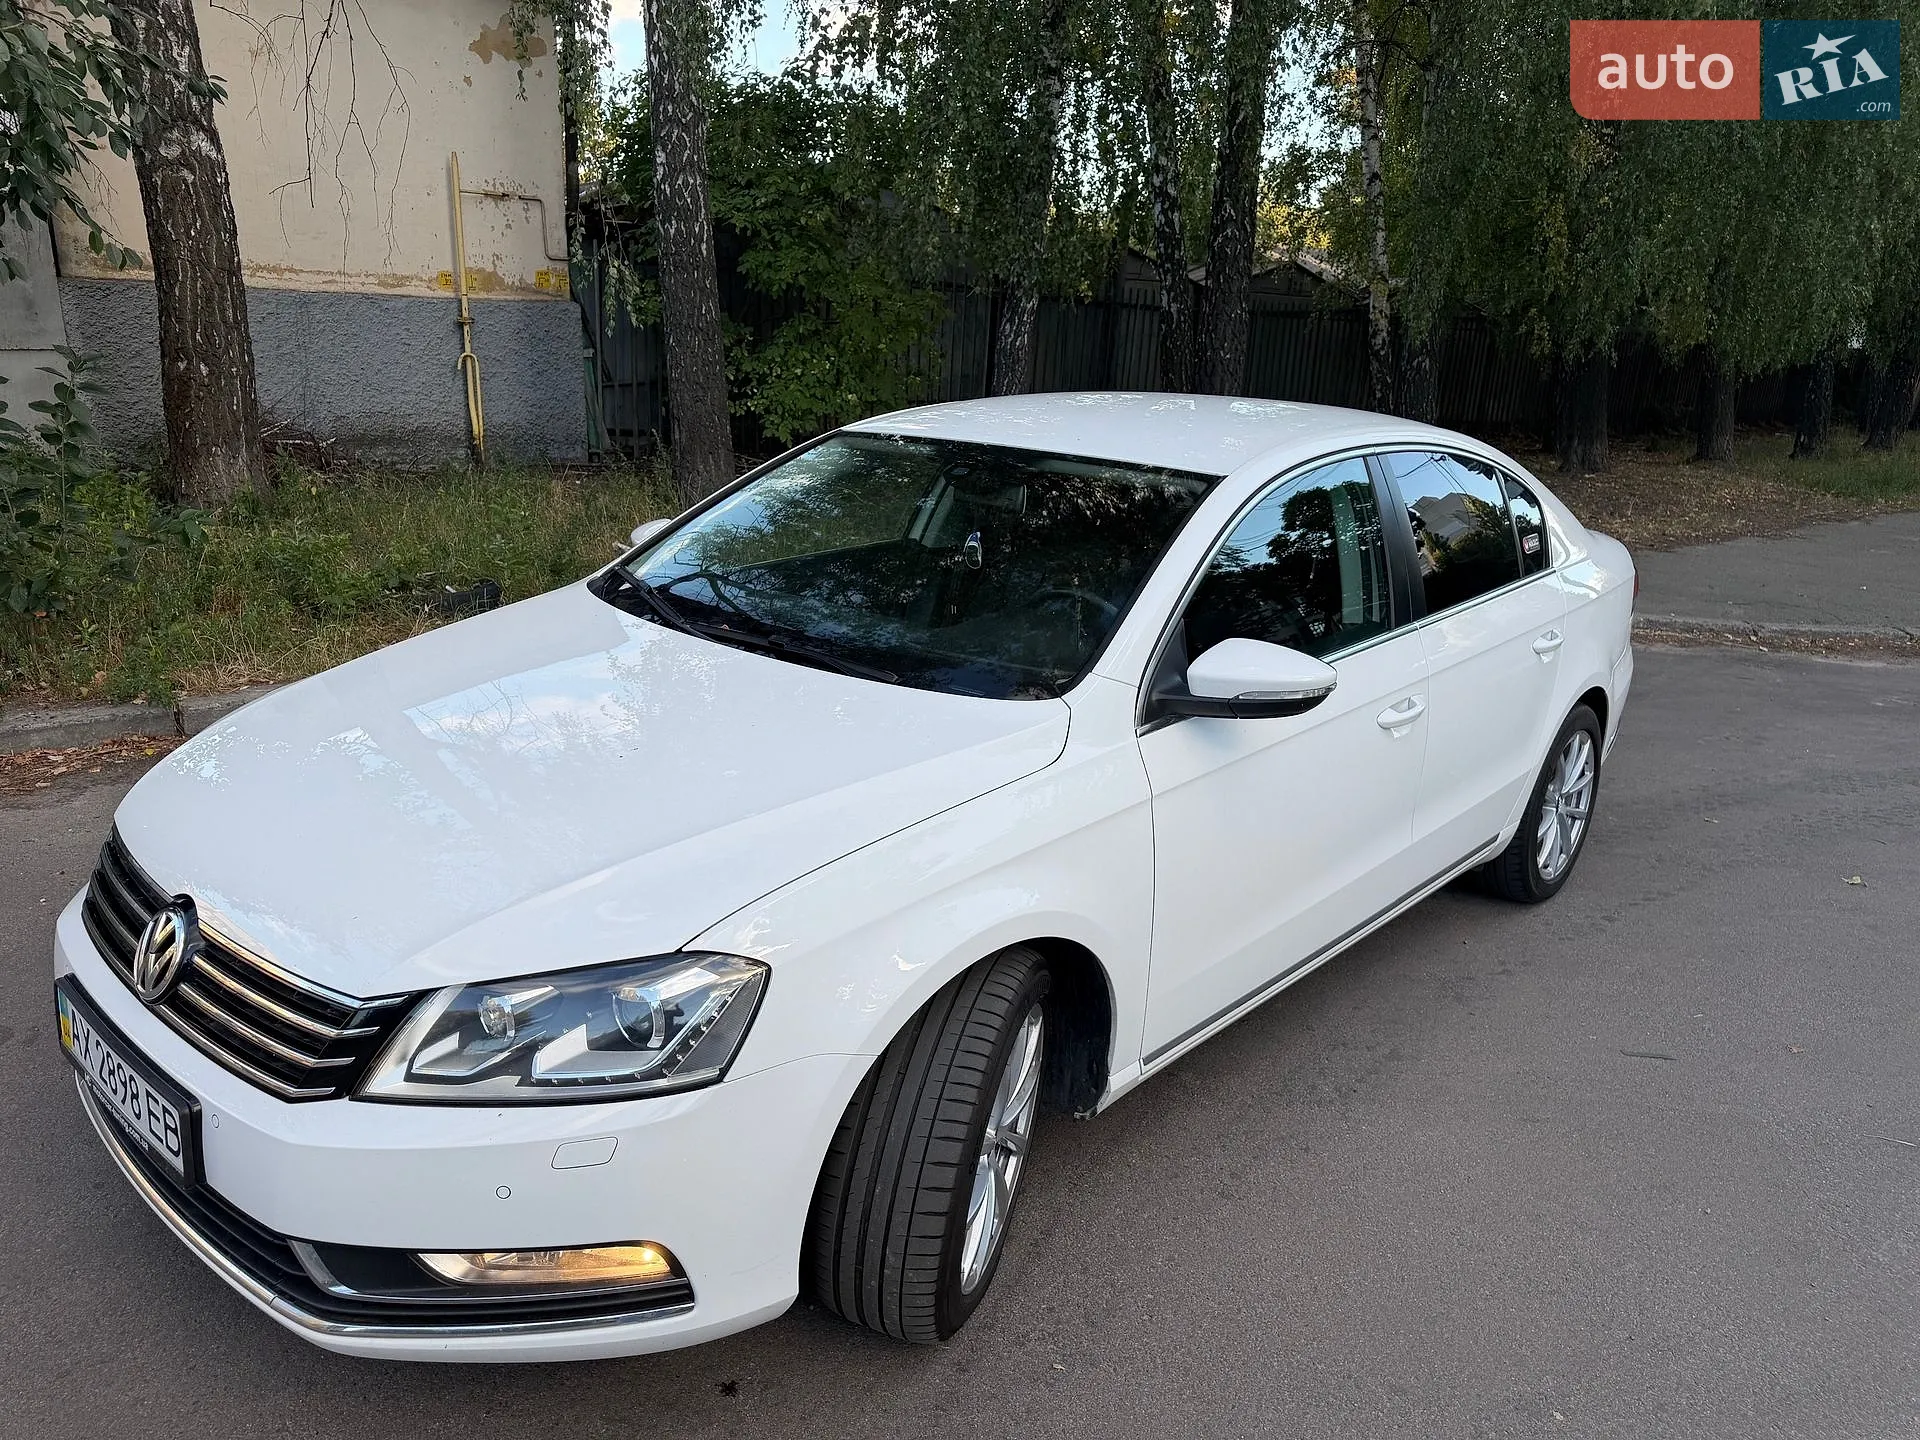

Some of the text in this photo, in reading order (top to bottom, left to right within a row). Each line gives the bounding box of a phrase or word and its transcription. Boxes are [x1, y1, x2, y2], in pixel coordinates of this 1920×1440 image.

[71, 1008, 95, 1071] AX
[96, 1039, 142, 1121] 2898
[145, 1087, 181, 1158] EB
